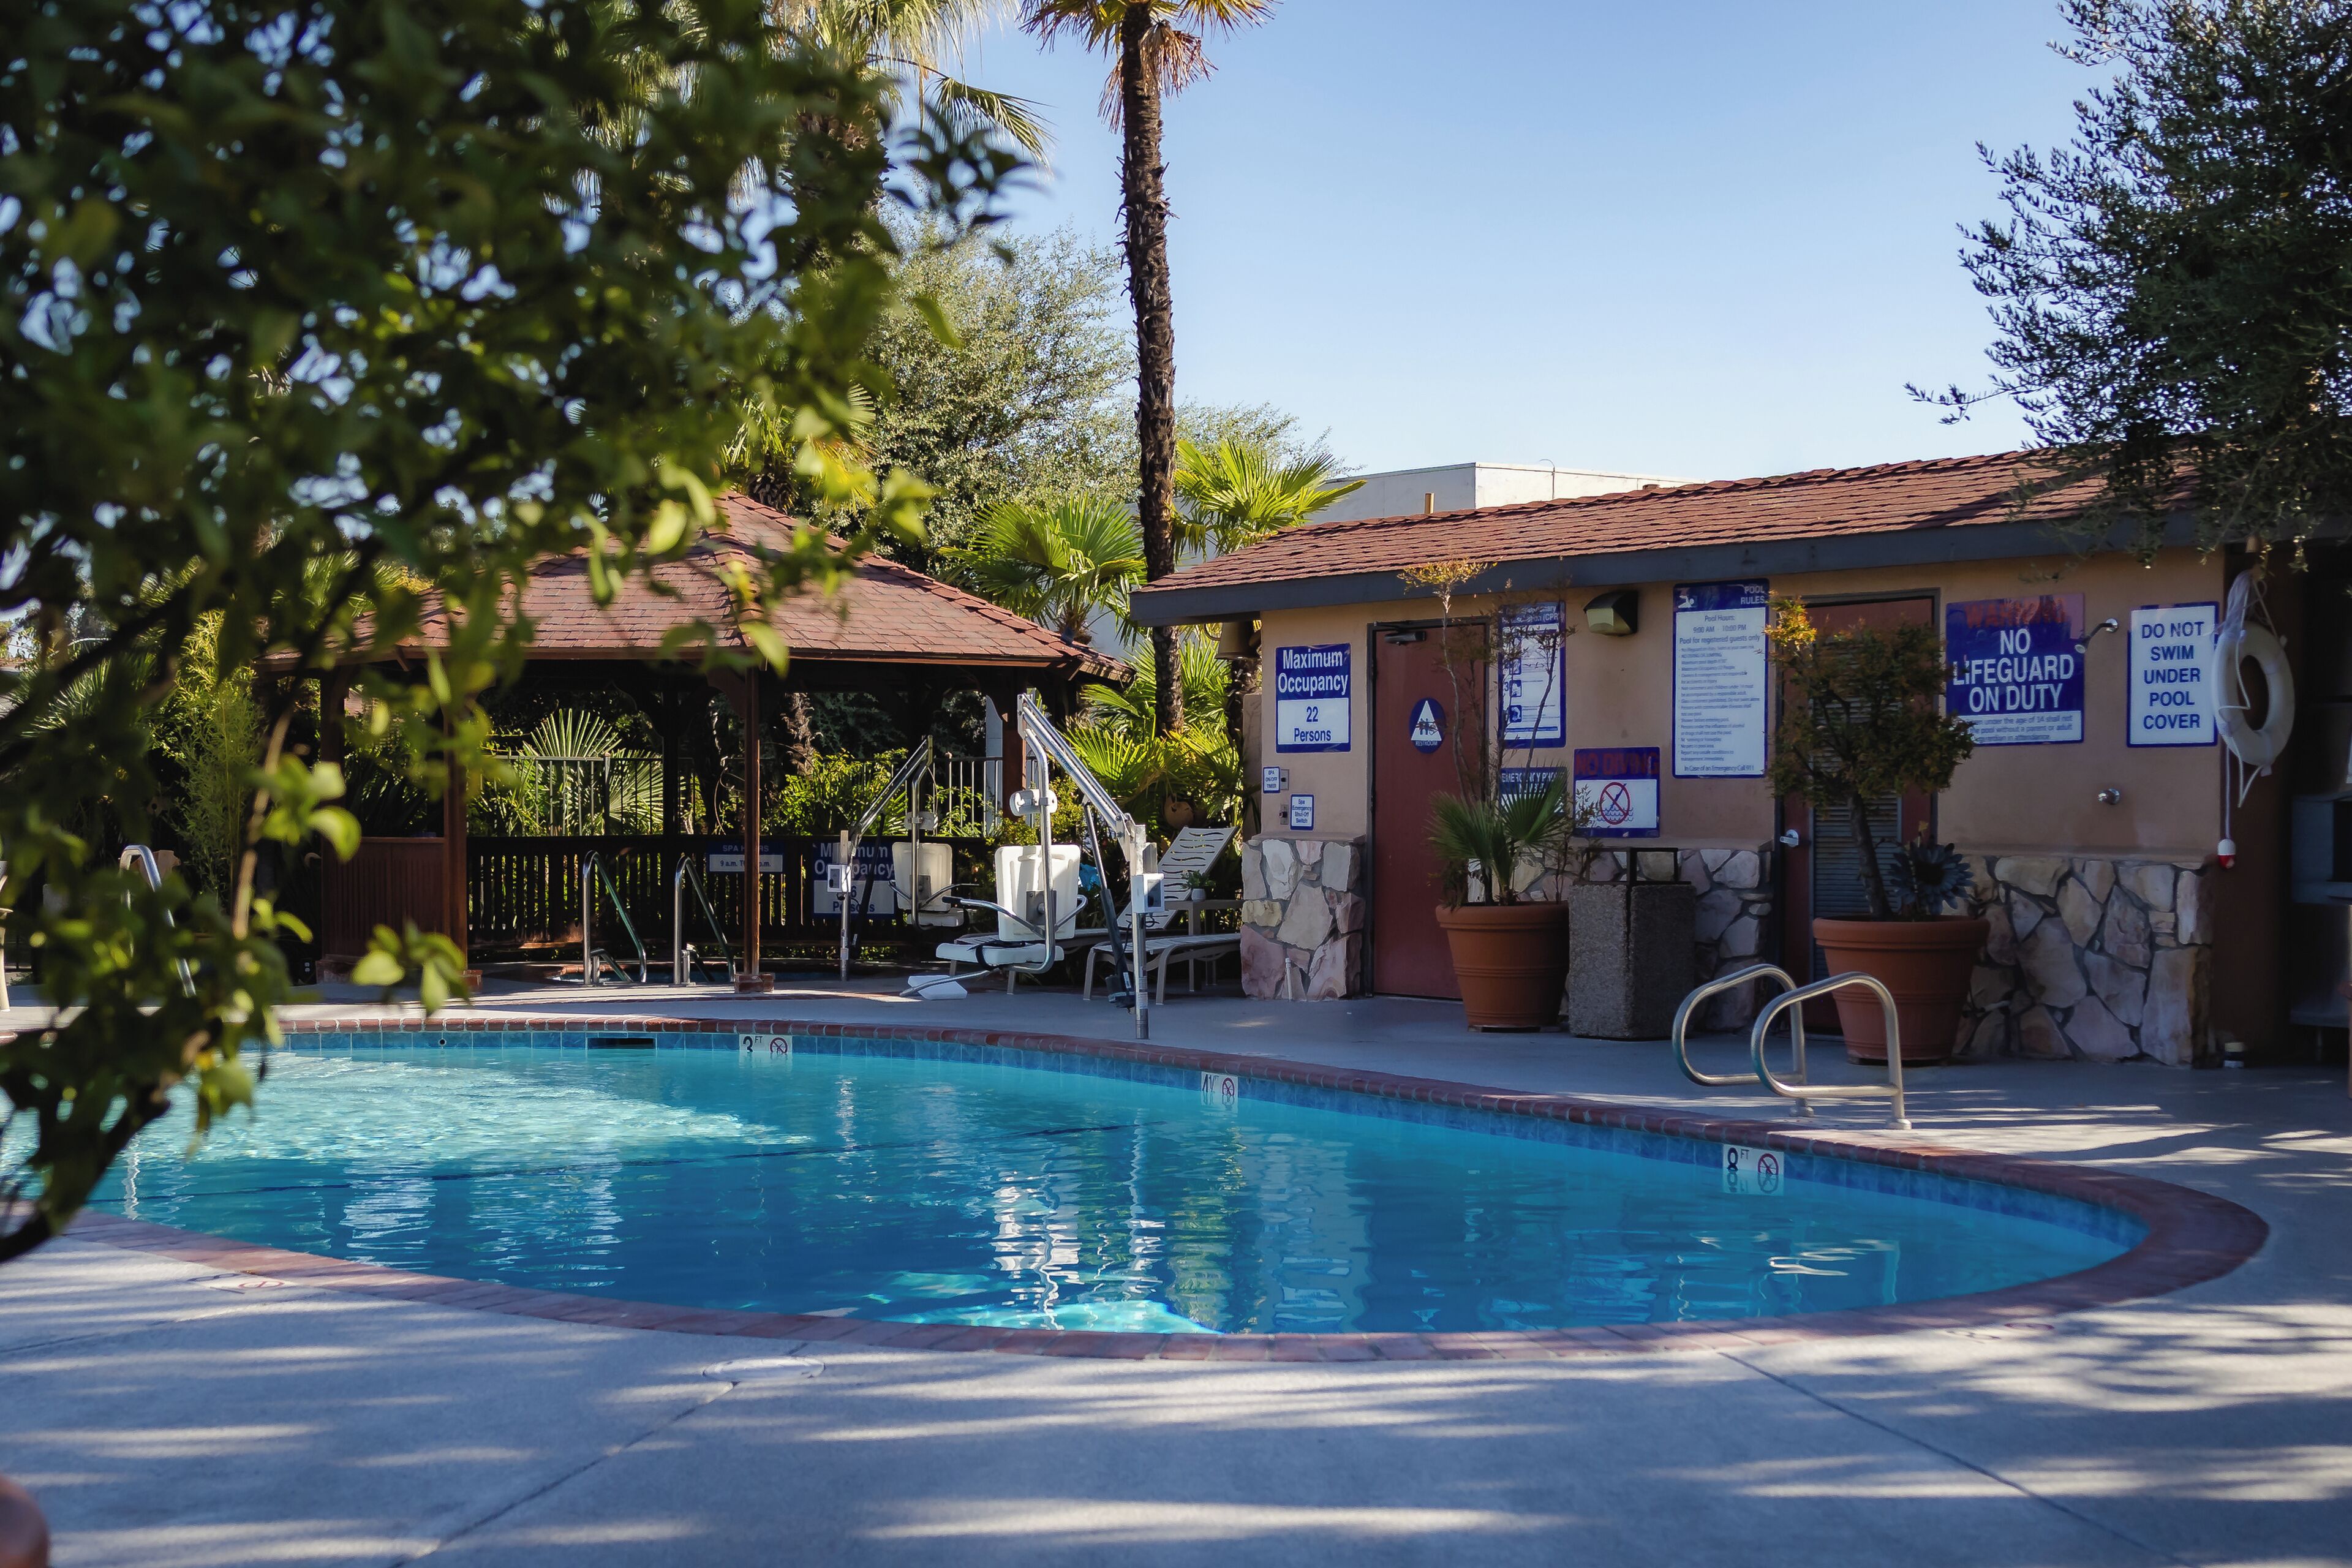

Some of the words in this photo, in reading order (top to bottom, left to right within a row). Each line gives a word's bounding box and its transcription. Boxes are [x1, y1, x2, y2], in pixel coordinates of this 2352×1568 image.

[1741, 595, 1765, 605] RULES
[2141, 623, 2165, 639] DO
[2170, 621, 2204, 638] NOT
[1701, 636, 1728, 645] registered
[2000, 628, 2031, 655] NO
[1283, 648, 1343, 670] Maximum
[2150, 646, 2195, 661] SWIM
[1953, 654, 2075, 685] LIFEGUARD
[2144, 668, 2201, 684] UNDER
[1278, 673, 1349, 696] Occupancy
[1969, 687, 1999, 712] ON
[2006, 683, 2064, 710] DUTY
[2149, 691, 2195, 707] POOL
[1306, 706, 1319, 723] 22
[2144, 714, 2201, 730] COVER
[1293, 727, 1332, 742] Persons
[1575, 753, 1599, 775] NO
[1502, 772, 1540, 782] EMERGNCY
[821, 843, 888, 858] Mmum
[815, 859, 894, 878] Opancy
[1741, 1149, 1750, 1159] FT
